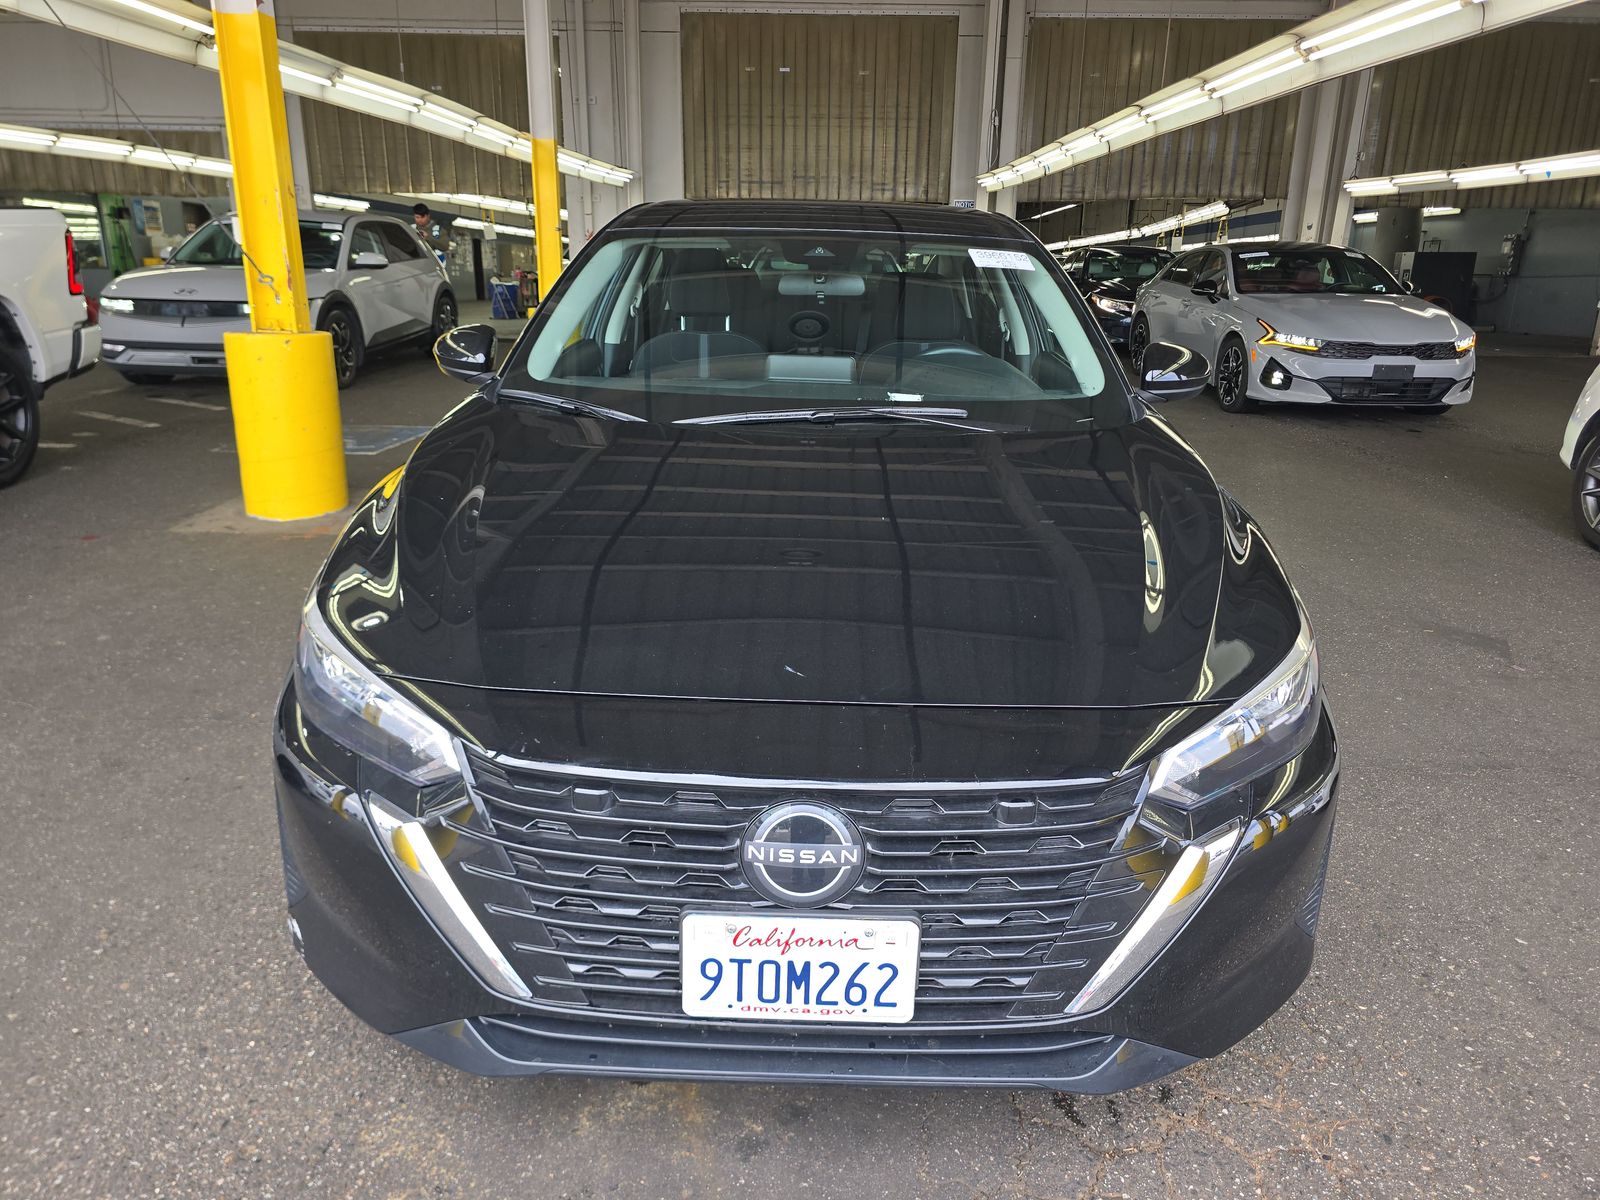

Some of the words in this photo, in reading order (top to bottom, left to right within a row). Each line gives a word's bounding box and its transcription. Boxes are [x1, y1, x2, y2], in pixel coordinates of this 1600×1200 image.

[748, 844, 858, 864] NISSAN
[732, 925, 874, 955] California
[741, 1005, 856, 1016] dmv.ca.gov
